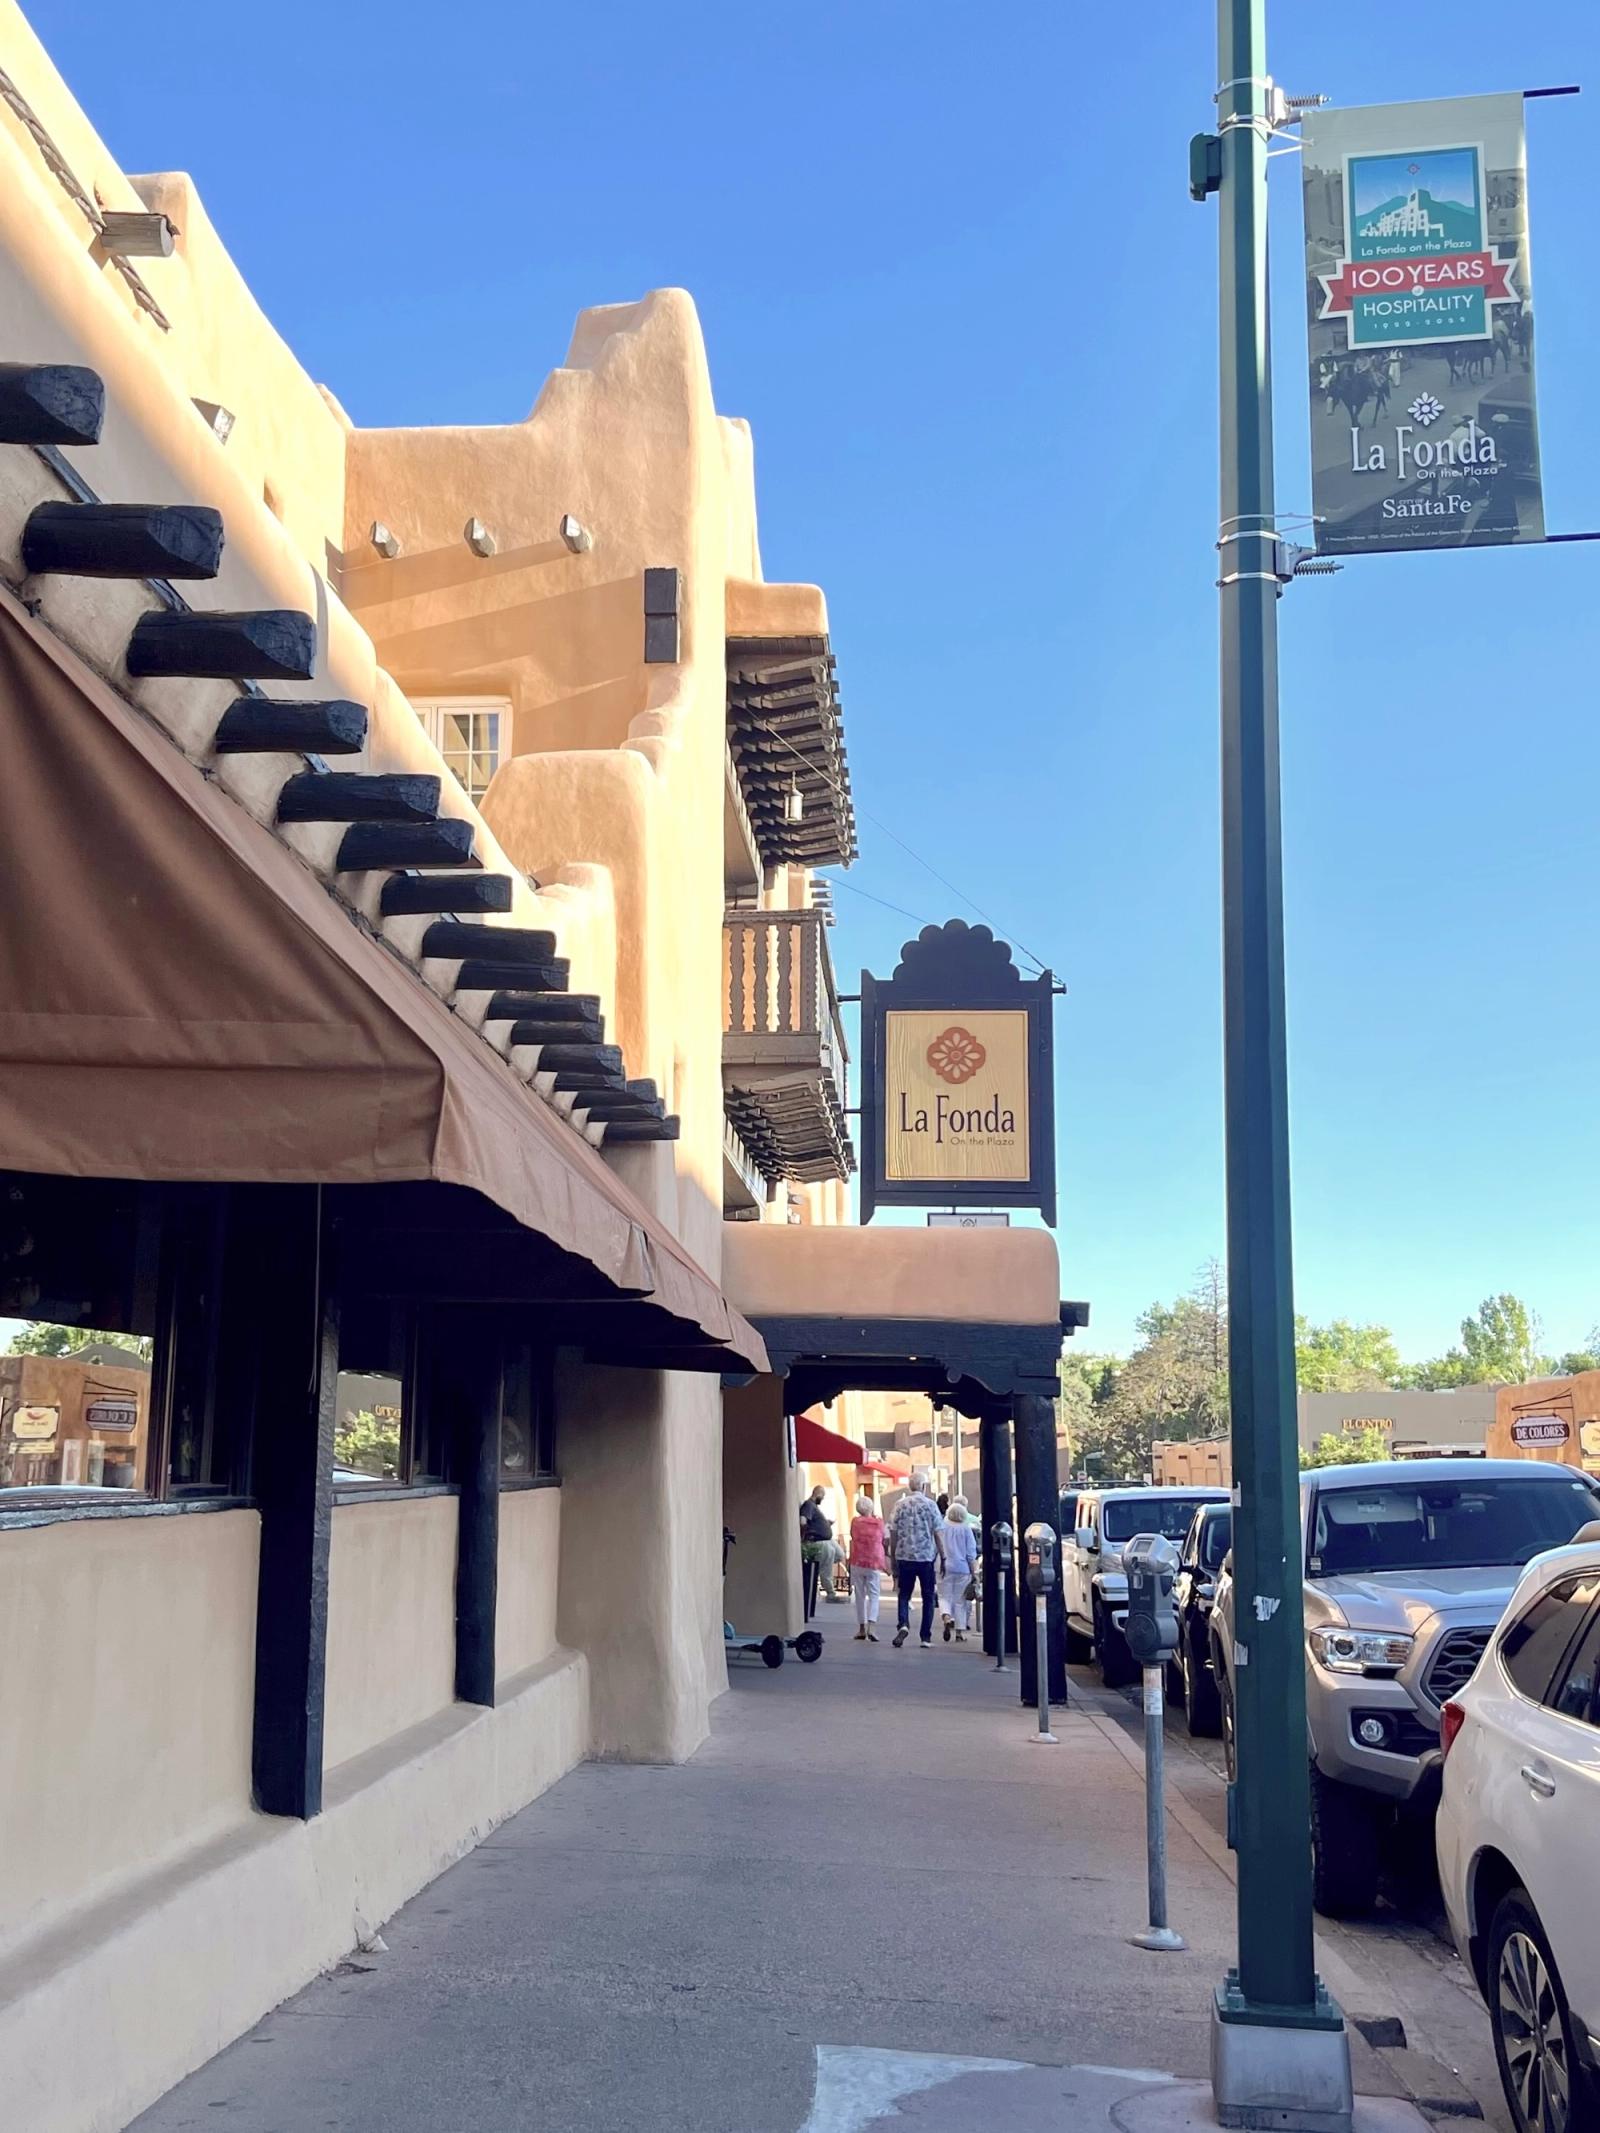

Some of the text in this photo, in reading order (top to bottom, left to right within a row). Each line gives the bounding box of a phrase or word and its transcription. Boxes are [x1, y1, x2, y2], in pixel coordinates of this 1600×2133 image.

[1361, 239, 1472, 257] La Fonda on the Plaza
[1363, 294, 1474, 317] HOSPITALITY
[1351, 419, 1497, 480] La Fonda
[1416, 465, 1498, 479] On the Plaza
[900, 1092, 1016, 1144] La Fonda
[950, 1135, 1015, 1146] On the Plaza
[1515, 1425, 1565, 1439] DE COLORES
